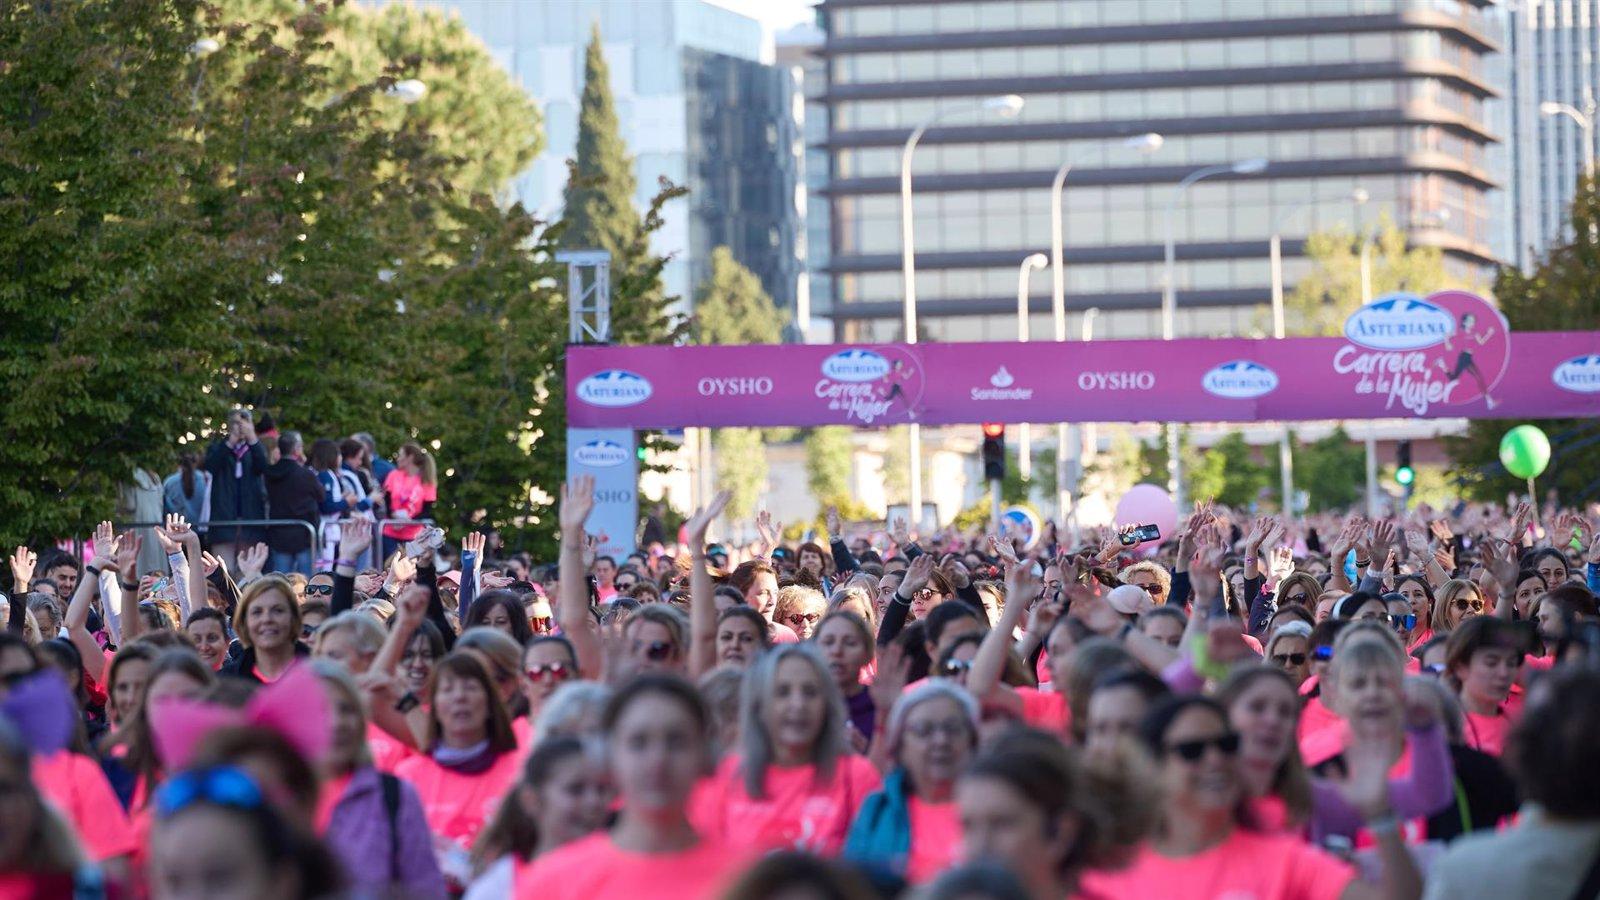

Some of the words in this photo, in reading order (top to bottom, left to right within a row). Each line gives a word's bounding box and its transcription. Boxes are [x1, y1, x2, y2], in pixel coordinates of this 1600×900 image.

[1355, 318, 1446, 337] ASTURIANA
[1332, 345, 1429, 374] Carrera
[698, 377, 774, 397] OYSHO
[815, 379, 873, 398] Carrera
[1078, 371, 1156, 391] OYSHO
[1208, 375, 1273, 389] ASTURIANA
[584, 384, 646, 398] ASTURIANA
[970, 387, 1034, 401] Santander
[1355, 376, 1375, 394] de
[1375, 372, 1390, 393] la
[1384, 370, 1460, 416] Mujer
[594, 488, 632, 503] SHO
